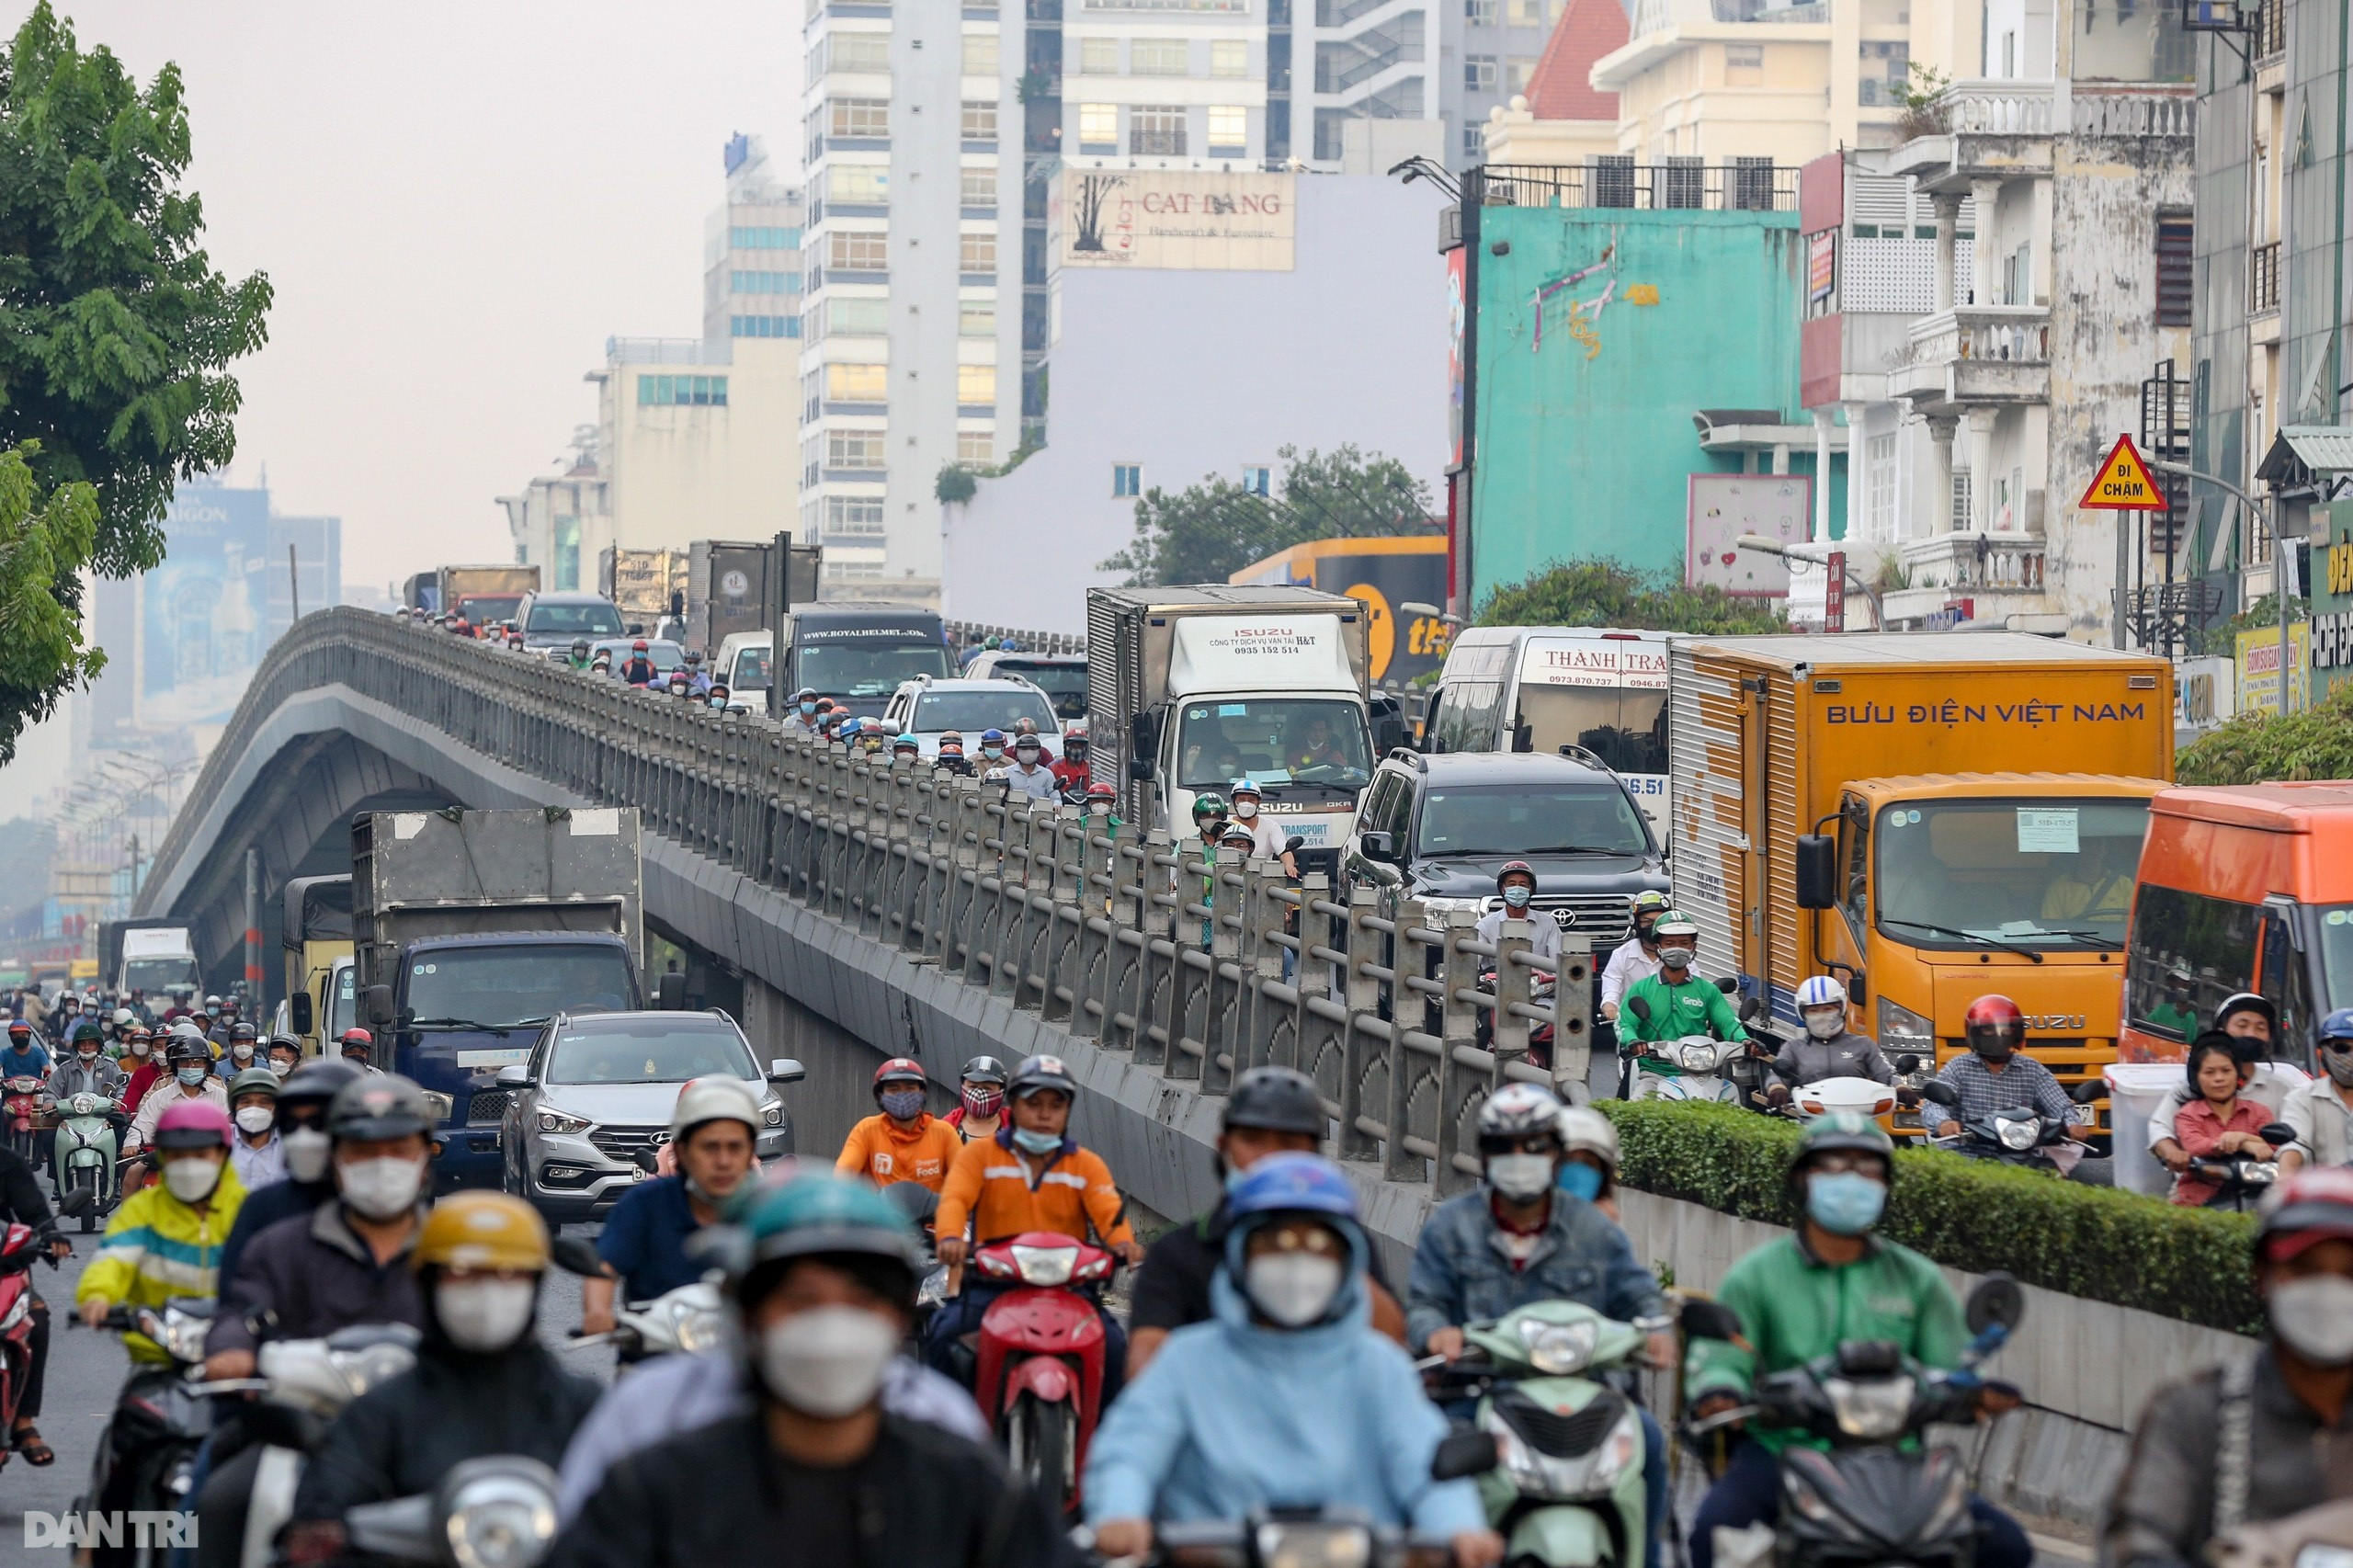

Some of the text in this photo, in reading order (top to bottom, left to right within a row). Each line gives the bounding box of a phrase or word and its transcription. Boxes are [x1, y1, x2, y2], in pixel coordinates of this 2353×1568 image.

[1142, 192, 1195, 213] CAT
[2118, 464, 2131, 477] ĐI
[2103, 482, 2143, 499] CHẬM
[167, 506, 228, 523] AIGON
[1234, 629, 1293, 637] ISUZU
[1210, 639, 1229, 647] CÔNG
[1296, 636, 1316, 646] H&T
[1234, 646, 1258, 654] 0935
[1262, 646, 1279, 654] 152
[1545, 649, 1666, 670] THÀNH TRA
[1549, 676, 1666, 687] 0973.870.737 0946.87
[1827, 698, 2143, 729] BƯU ĐIỆN VIỆT NAM
[1257, 802, 1303, 812] SUZU
[1281, 824, 1328, 835] TRANSPORT
[1683, 996, 1704, 1007] Grab
[2022, 1015, 2086, 1029] SUZU
[916, 1164, 939, 1177] Food
